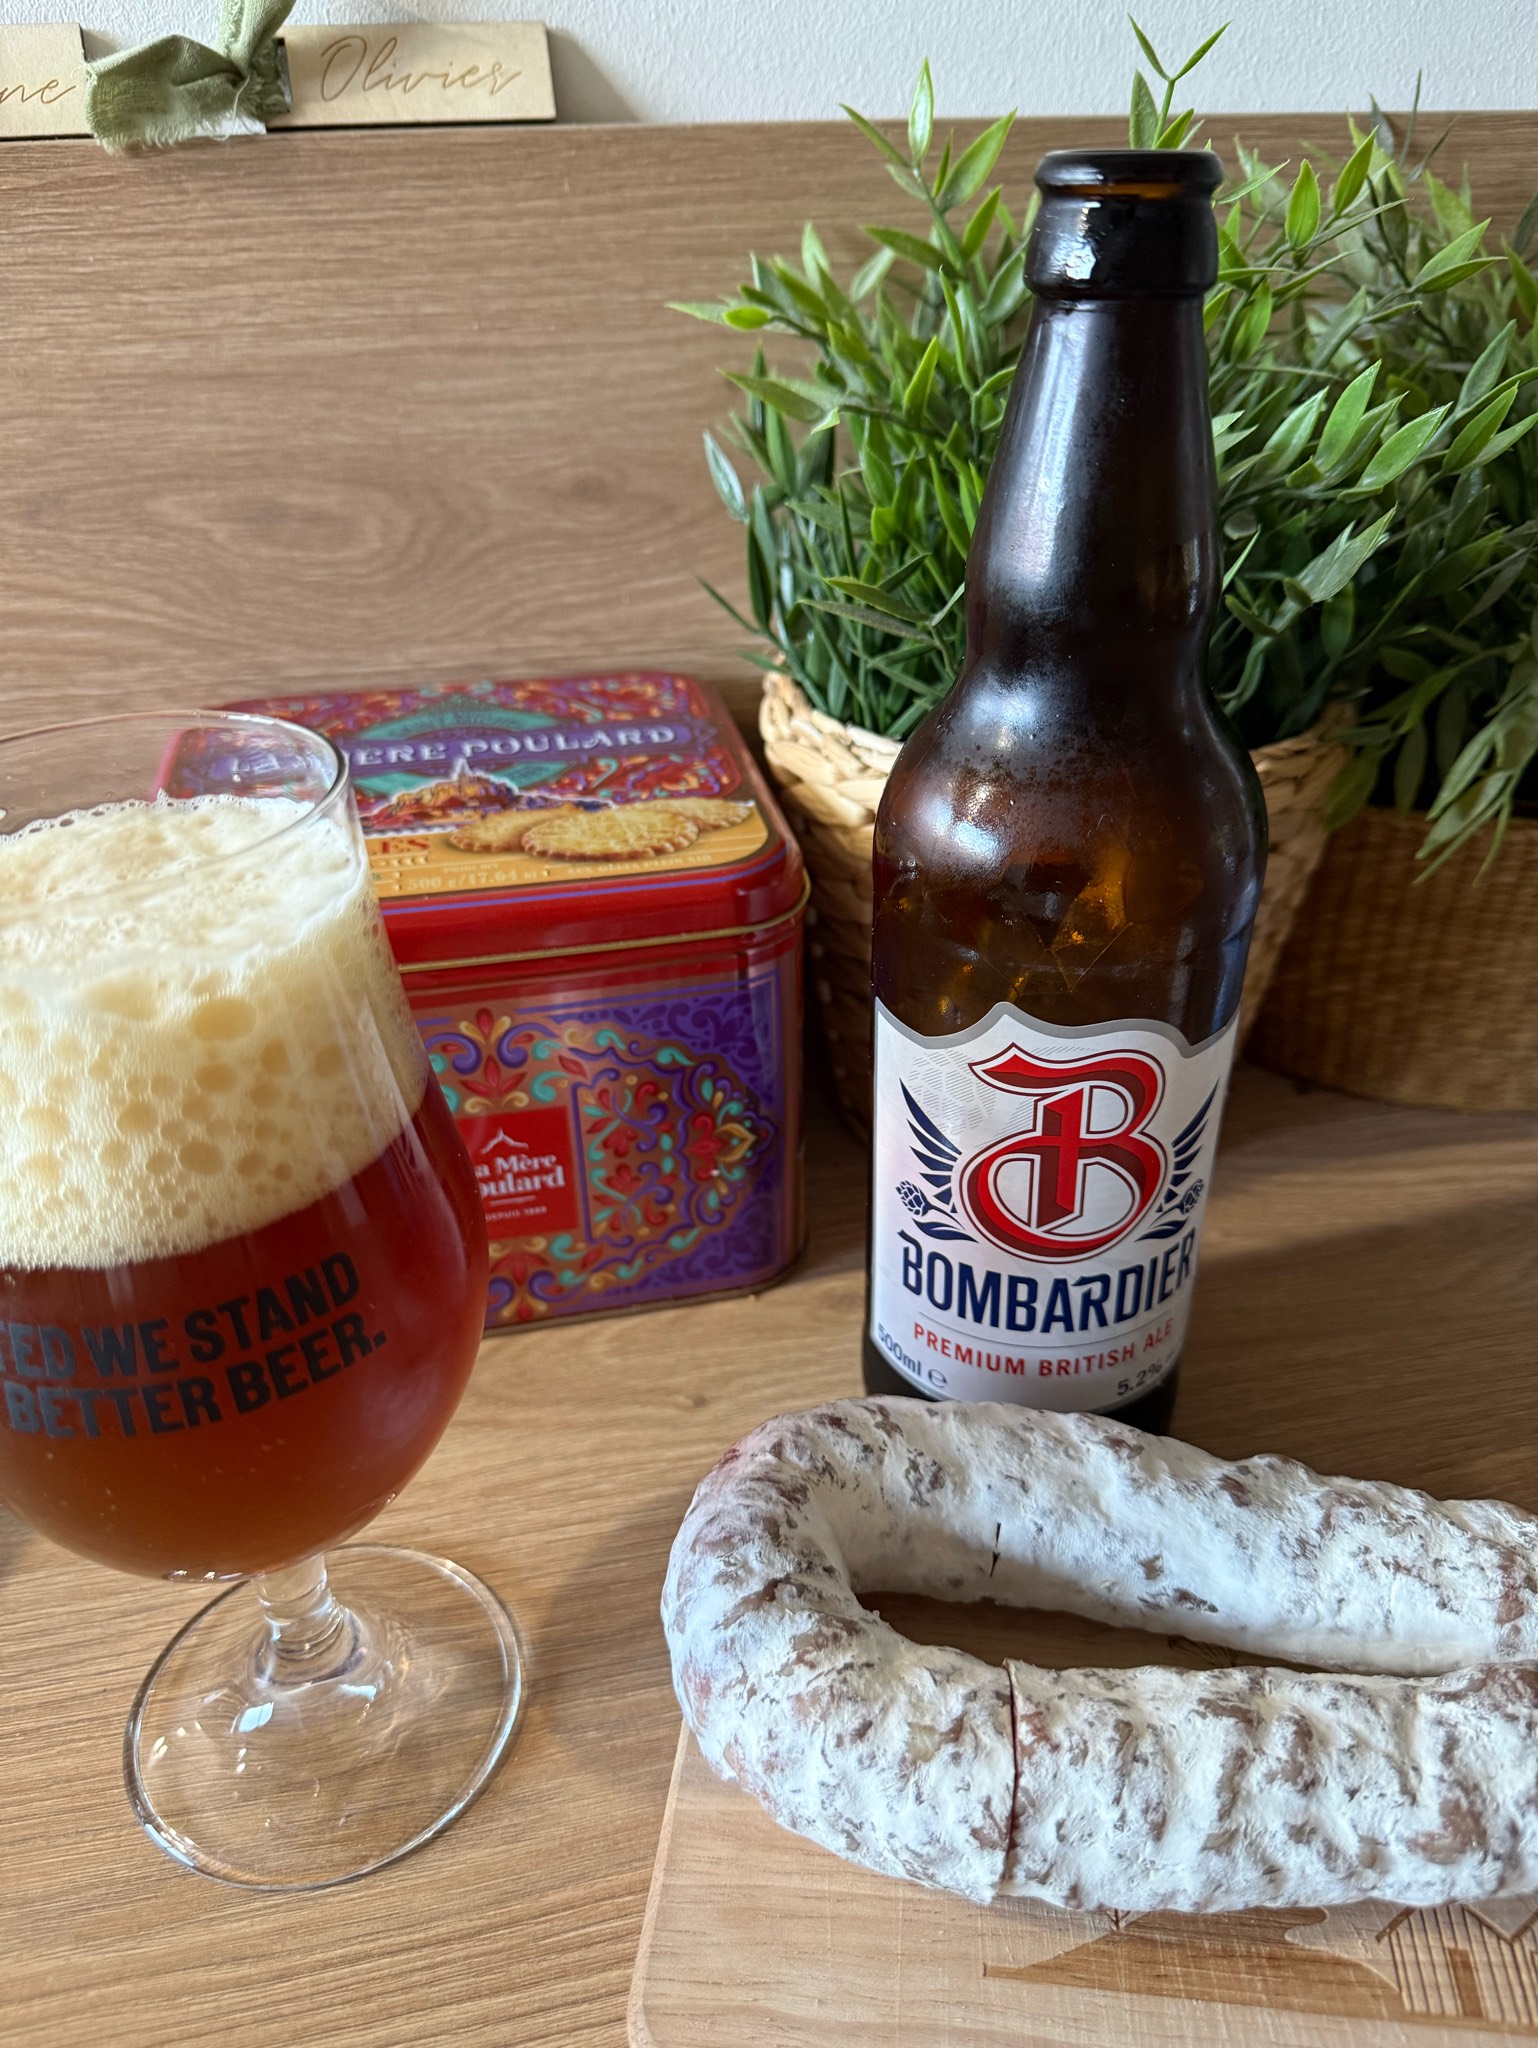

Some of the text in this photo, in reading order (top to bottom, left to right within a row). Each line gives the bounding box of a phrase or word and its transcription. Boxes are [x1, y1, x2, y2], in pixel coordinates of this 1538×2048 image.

[320, 35, 523, 102] Olivier
[355, 742, 447, 767] ERE
[462, 725, 676, 758] POULARD
[474, 1153, 558, 1178] a Mère
[478, 1165, 566, 1199] oulard
[959, 1042, 1168, 1264] B
[898, 1227, 1197, 1333] BOMBARDIER
[81, 1318, 181, 1377] WE
[184, 1252, 360, 1363] STAND
[4, 1312, 387, 1439] BETTER BEER.
[879, 1322, 922, 1377] 500ml
[914, 1321, 1026, 1377] PREMIUM
[1038, 1342, 1135, 1377] BRITISH
[1142, 1317, 1172, 1353] ALE
[1117, 1359, 1163, 1396] 5.2%
